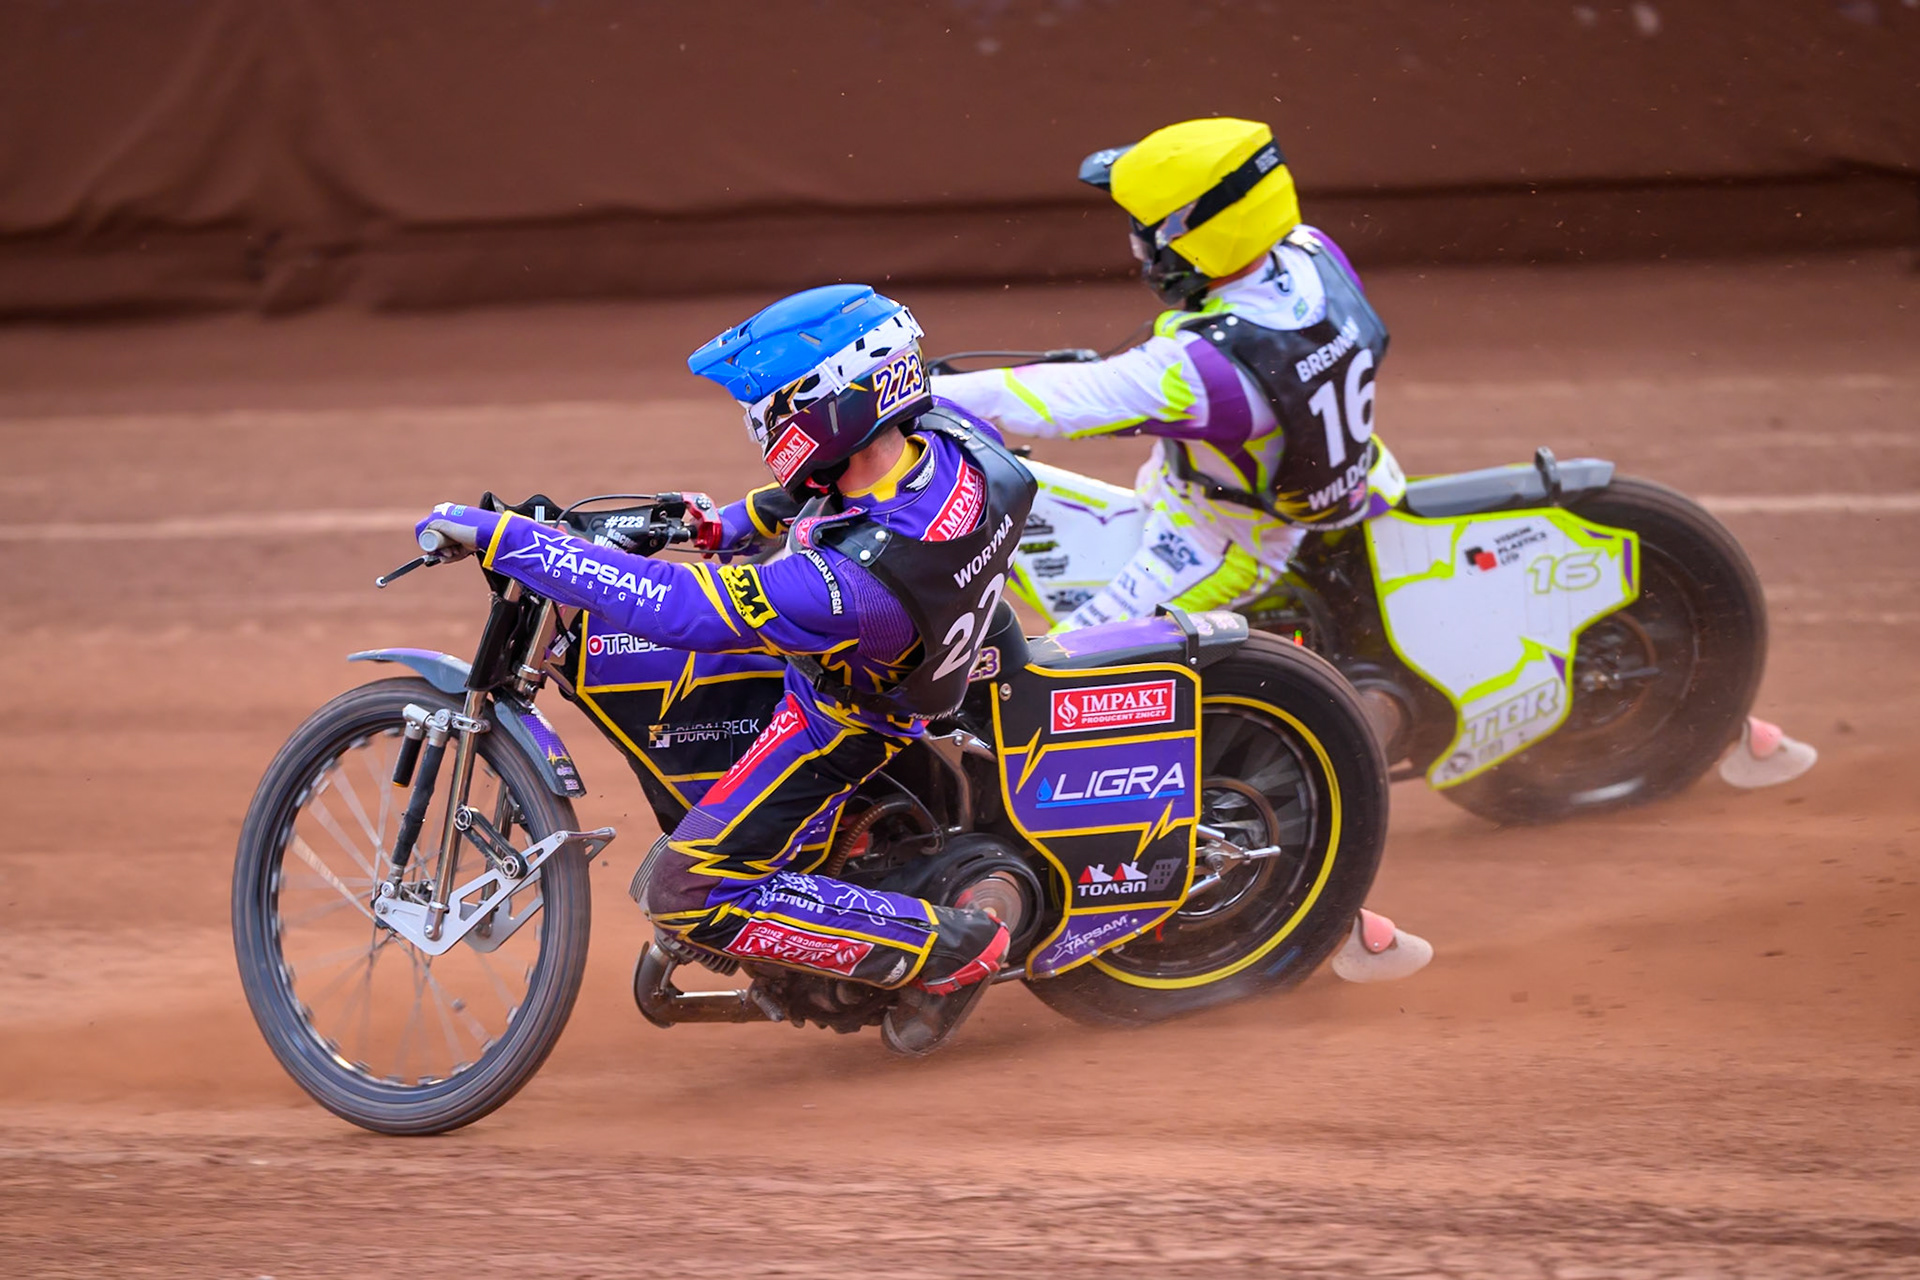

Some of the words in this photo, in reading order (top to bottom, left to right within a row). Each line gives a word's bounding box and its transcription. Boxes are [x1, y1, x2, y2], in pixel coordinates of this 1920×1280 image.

[874, 352, 924, 414] 223
[1308, 348, 1375, 469] 16
[772, 432, 805, 470] IMPAKT
[604, 515, 645, 529] #223
[953, 513, 1014, 589] WORYNA
[545, 543, 668, 603] TAPSAM
[551, 568, 662, 613] DESIGNS
[1526, 550, 1602, 595] 16
[1081, 688, 1168, 713] IMPAKT
[1081, 712, 1134, 724] PRODUCENT
[1135, 709, 1167, 719] ZNICZY
[1052, 762, 1185, 801] LIGRA
[1066, 915, 1127, 954] TAPSAM
